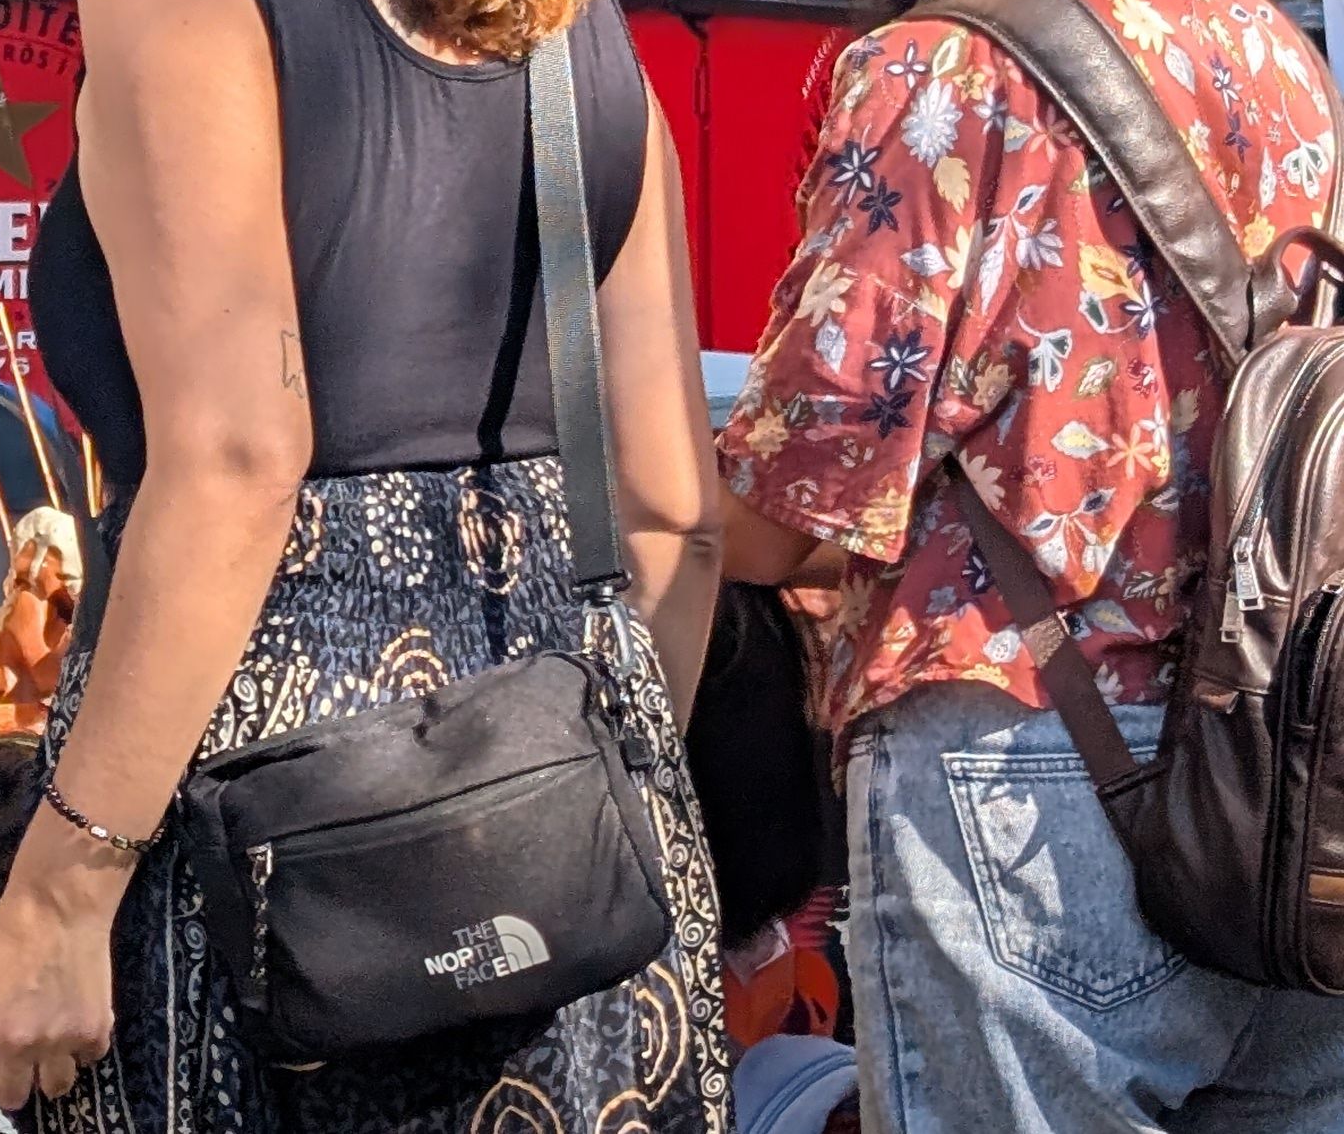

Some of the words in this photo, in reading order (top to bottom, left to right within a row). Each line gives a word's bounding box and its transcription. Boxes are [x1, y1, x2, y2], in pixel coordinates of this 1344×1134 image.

[452, 919, 497, 947] THE
[423, 938, 502, 976] NORTH
[454, 955, 511, 990] FACE
